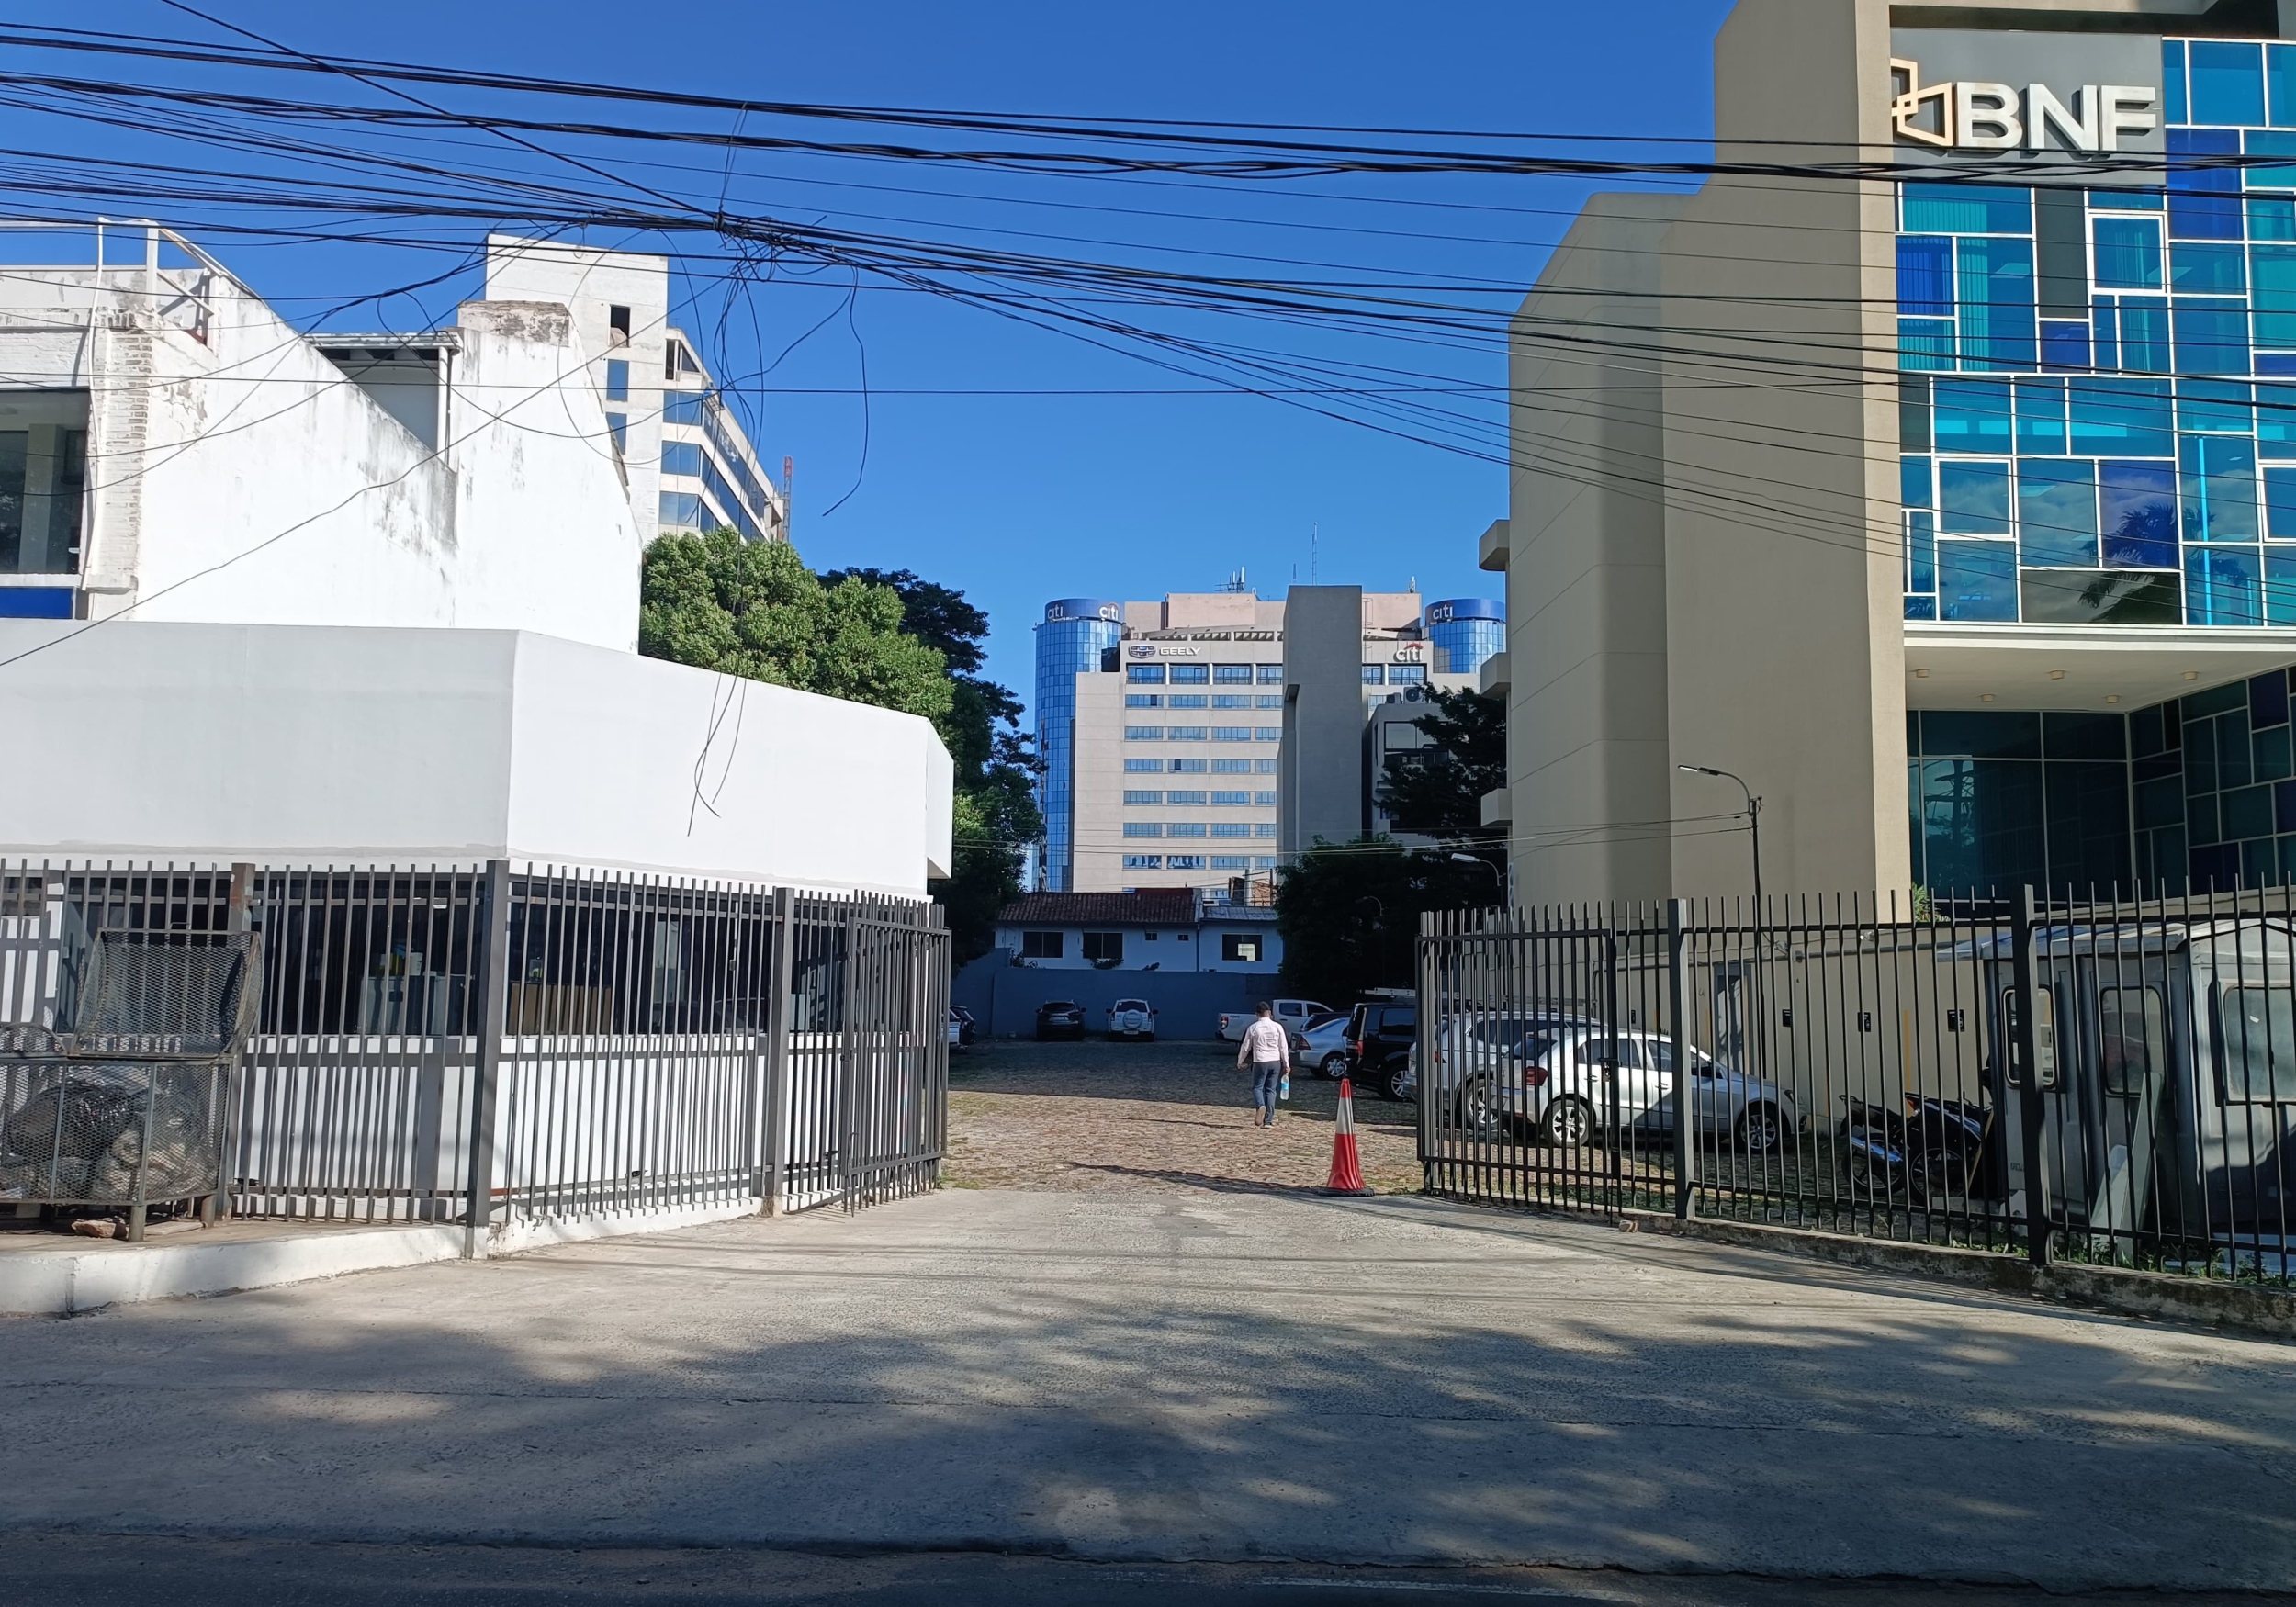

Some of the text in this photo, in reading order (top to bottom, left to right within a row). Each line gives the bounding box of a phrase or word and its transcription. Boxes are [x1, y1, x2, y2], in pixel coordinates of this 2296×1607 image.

[1955, 81, 2156, 152] BNF
[1099, 605, 1119, 621] citi
[1433, 604, 1453, 620] citi
[1159, 646, 1201, 656] GEELY
[1395, 646, 1423, 661] citi
